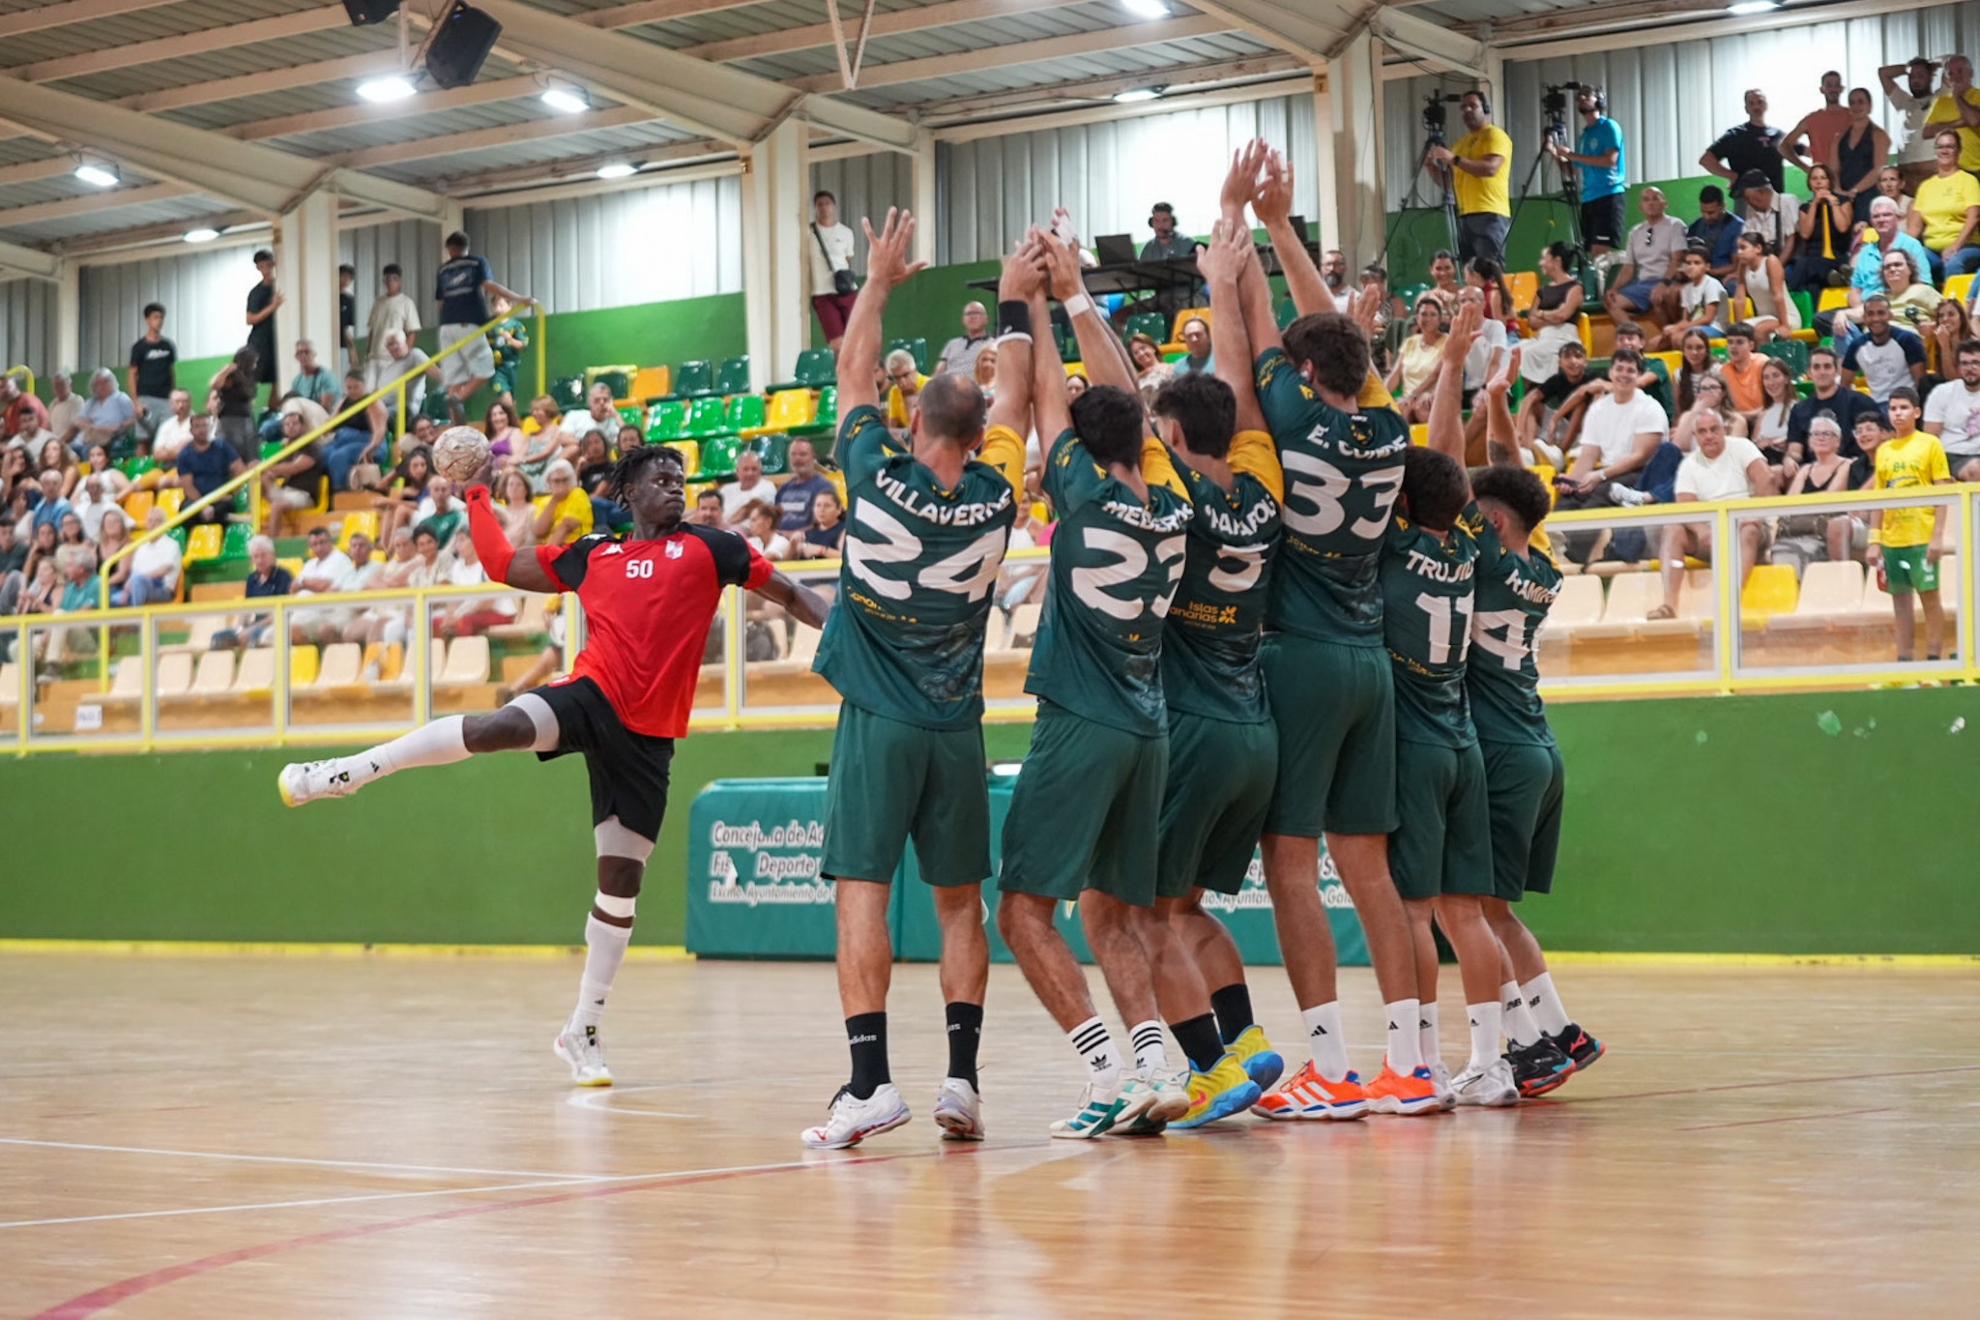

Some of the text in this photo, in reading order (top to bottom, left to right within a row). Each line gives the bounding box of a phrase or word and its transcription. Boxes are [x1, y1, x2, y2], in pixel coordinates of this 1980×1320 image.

[1281, 450, 1405, 540] 33
[846, 497, 1006, 603] 24
[626, 559, 654, 578] 50
[1071, 527, 1186, 620] 23
[786, 820, 806, 846] de
[757, 852, 815, 882] Deporte
[746, 881, 815, 906] Ayuntamiento
